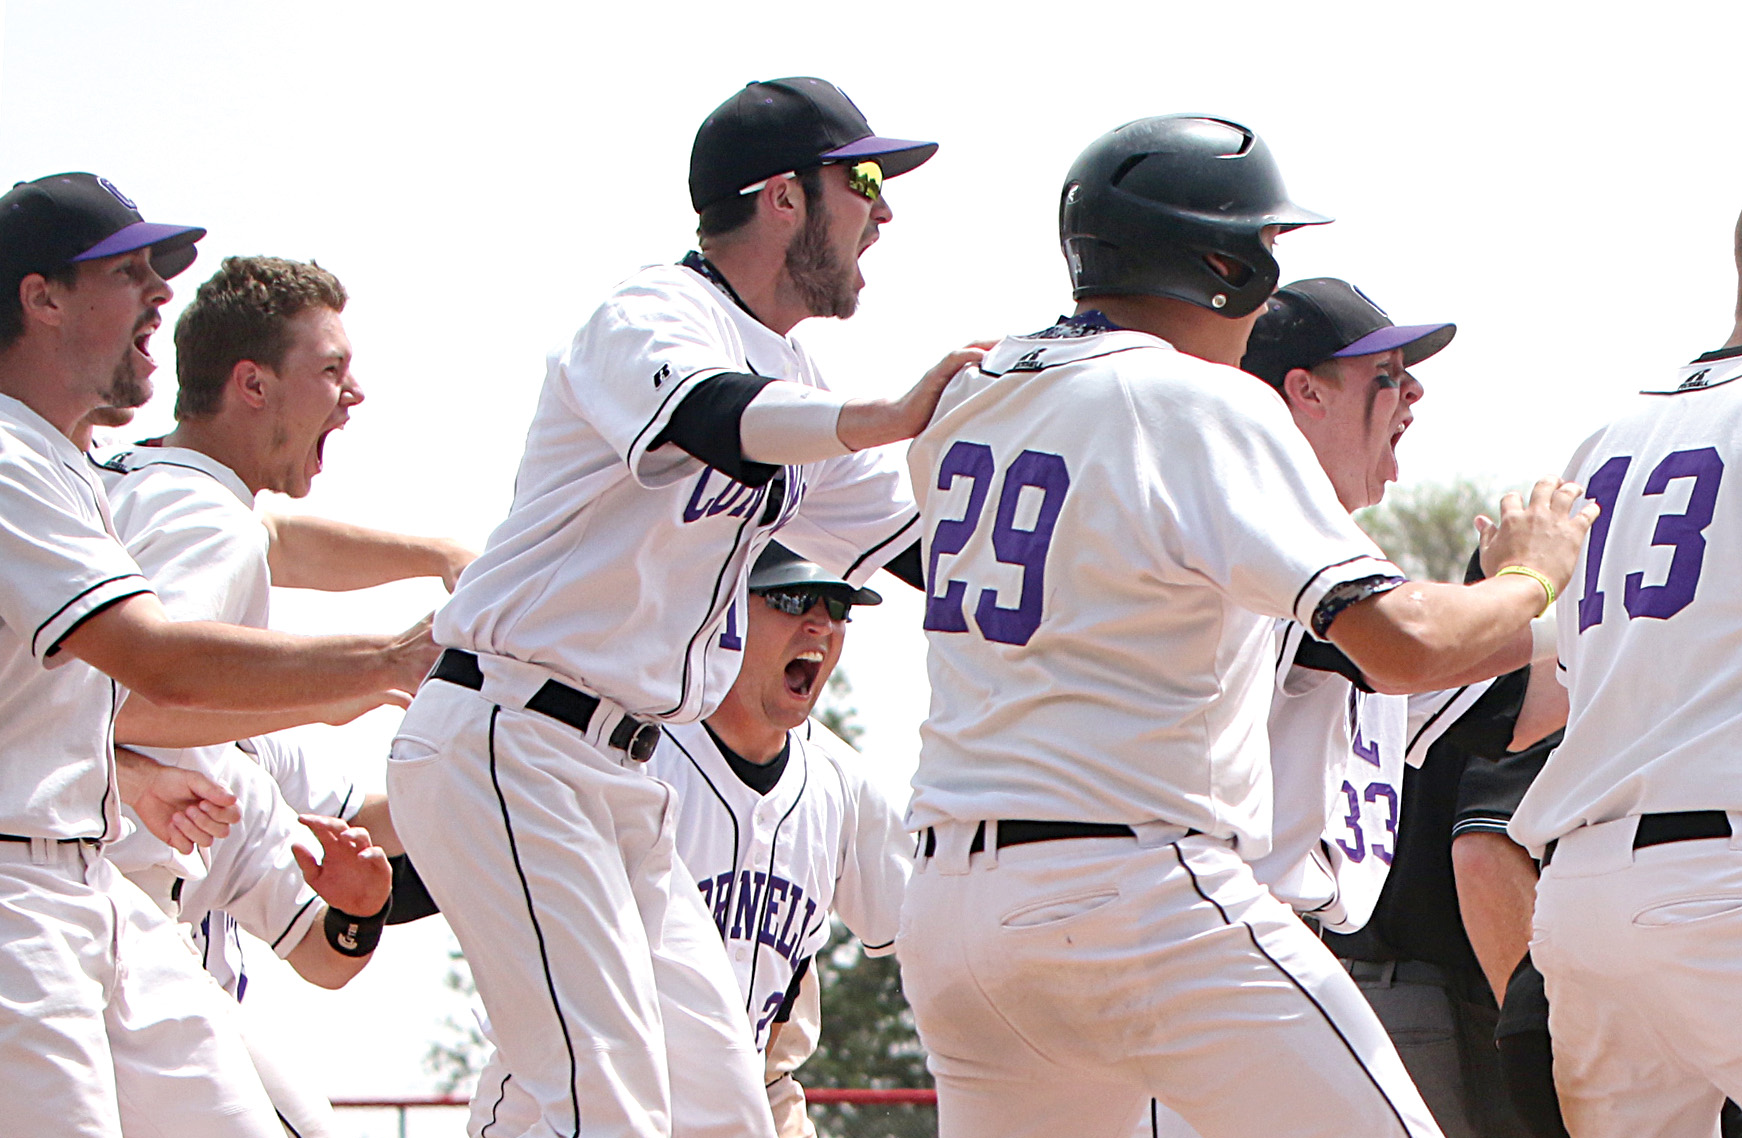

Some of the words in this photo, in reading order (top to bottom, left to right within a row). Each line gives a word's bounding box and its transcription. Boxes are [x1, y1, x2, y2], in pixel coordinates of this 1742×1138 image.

[923, 440, 1070, 647] 29
[1578, 446, 1725, 635] 13
[1335, 779, 1398, 867] 33
